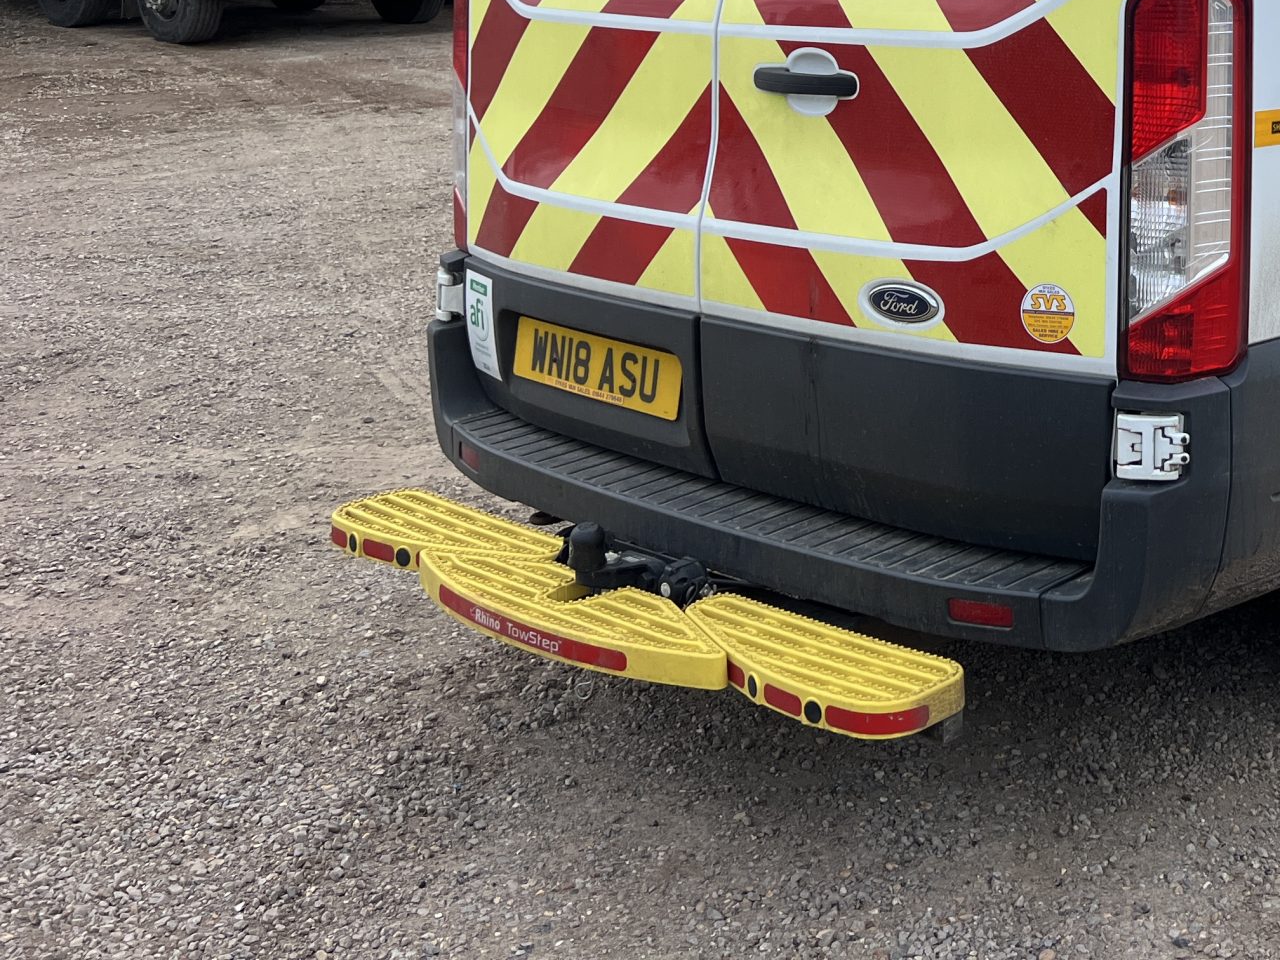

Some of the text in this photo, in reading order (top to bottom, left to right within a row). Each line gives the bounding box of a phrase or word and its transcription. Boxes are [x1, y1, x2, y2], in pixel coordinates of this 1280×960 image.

[470, 298, 486, 331] afi
[880, 291, 919, 315] Ford
[1031, 293, 1066, 311] SVS
[531, 328, 660, 403] WN18 ASU
[475, 607, 559, 653] Rhino TowStep
